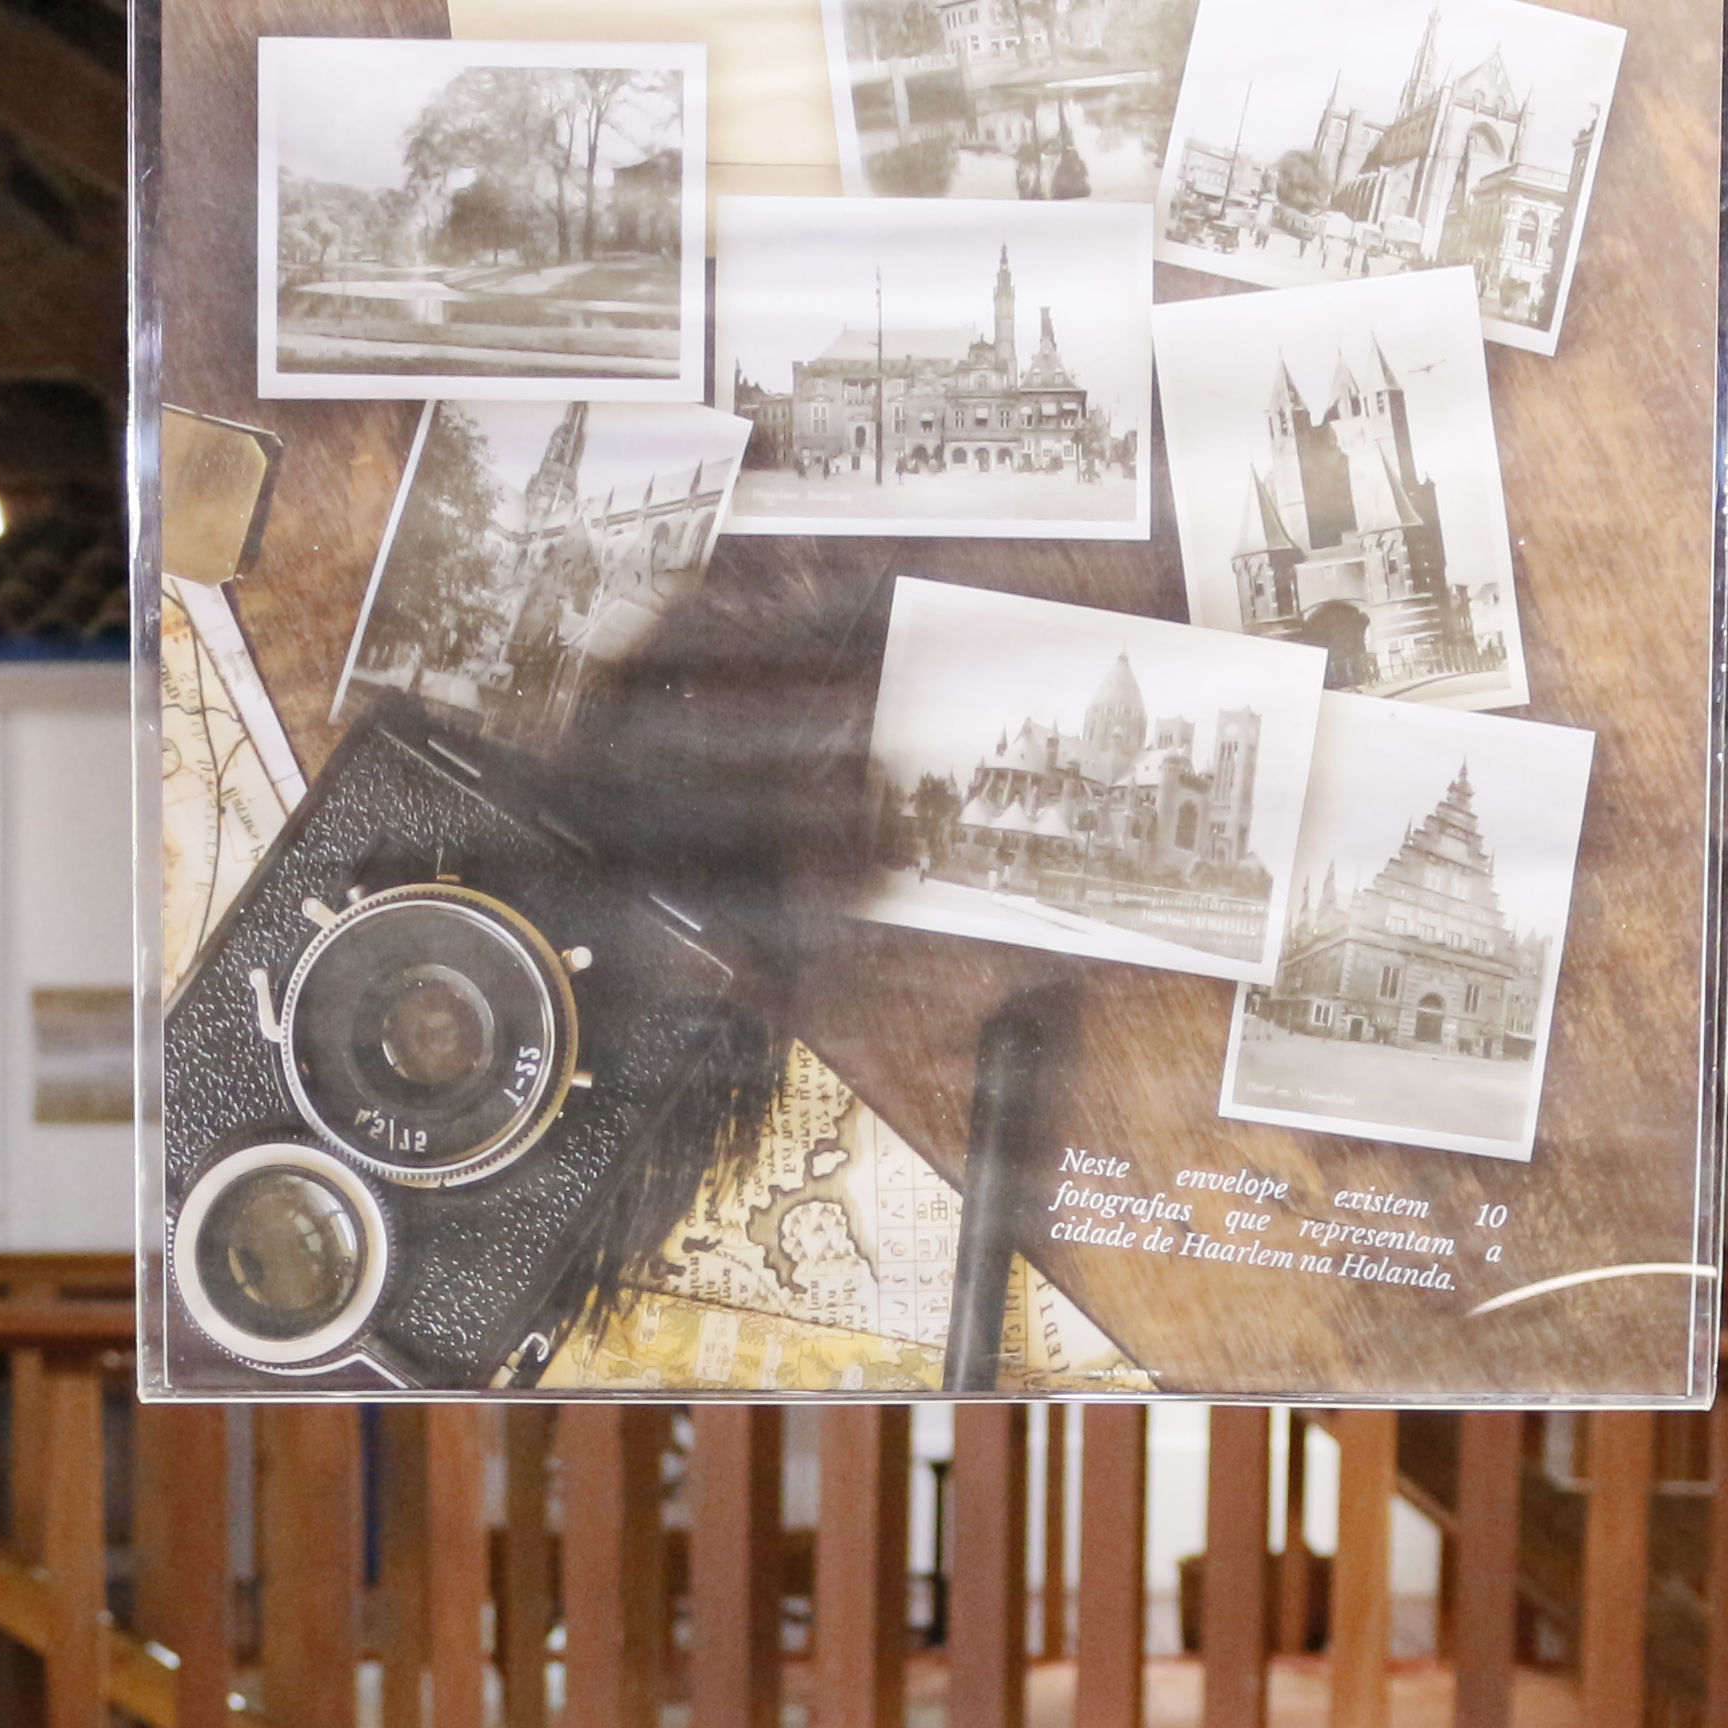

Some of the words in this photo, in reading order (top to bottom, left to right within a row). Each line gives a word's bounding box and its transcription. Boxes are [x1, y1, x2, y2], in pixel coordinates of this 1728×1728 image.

[1047, 1180, 1193, 1223] fotografias
[1224, 1210, 1272, 1235] que
[1300, 1219, 1455, 1256] representam
[1485, 1245, 1503, 1263] a
[1058, 1147, 1131, 1179] Neste
[1175, 1169, 1289, 1204] envelope
[1334, 1185, 1430, 1219] existem
[1474, 1203, 1508, 1229] 10
[1050, 1215, 1137, 1249] cidade
[1142, 1226, 1174, 1254] de
[1178, 1232, 1294, 1269] Haarlem
[1299, 1254, 1333, 1275] na
[1337, 1253, 1456, 1291] Holanda.
